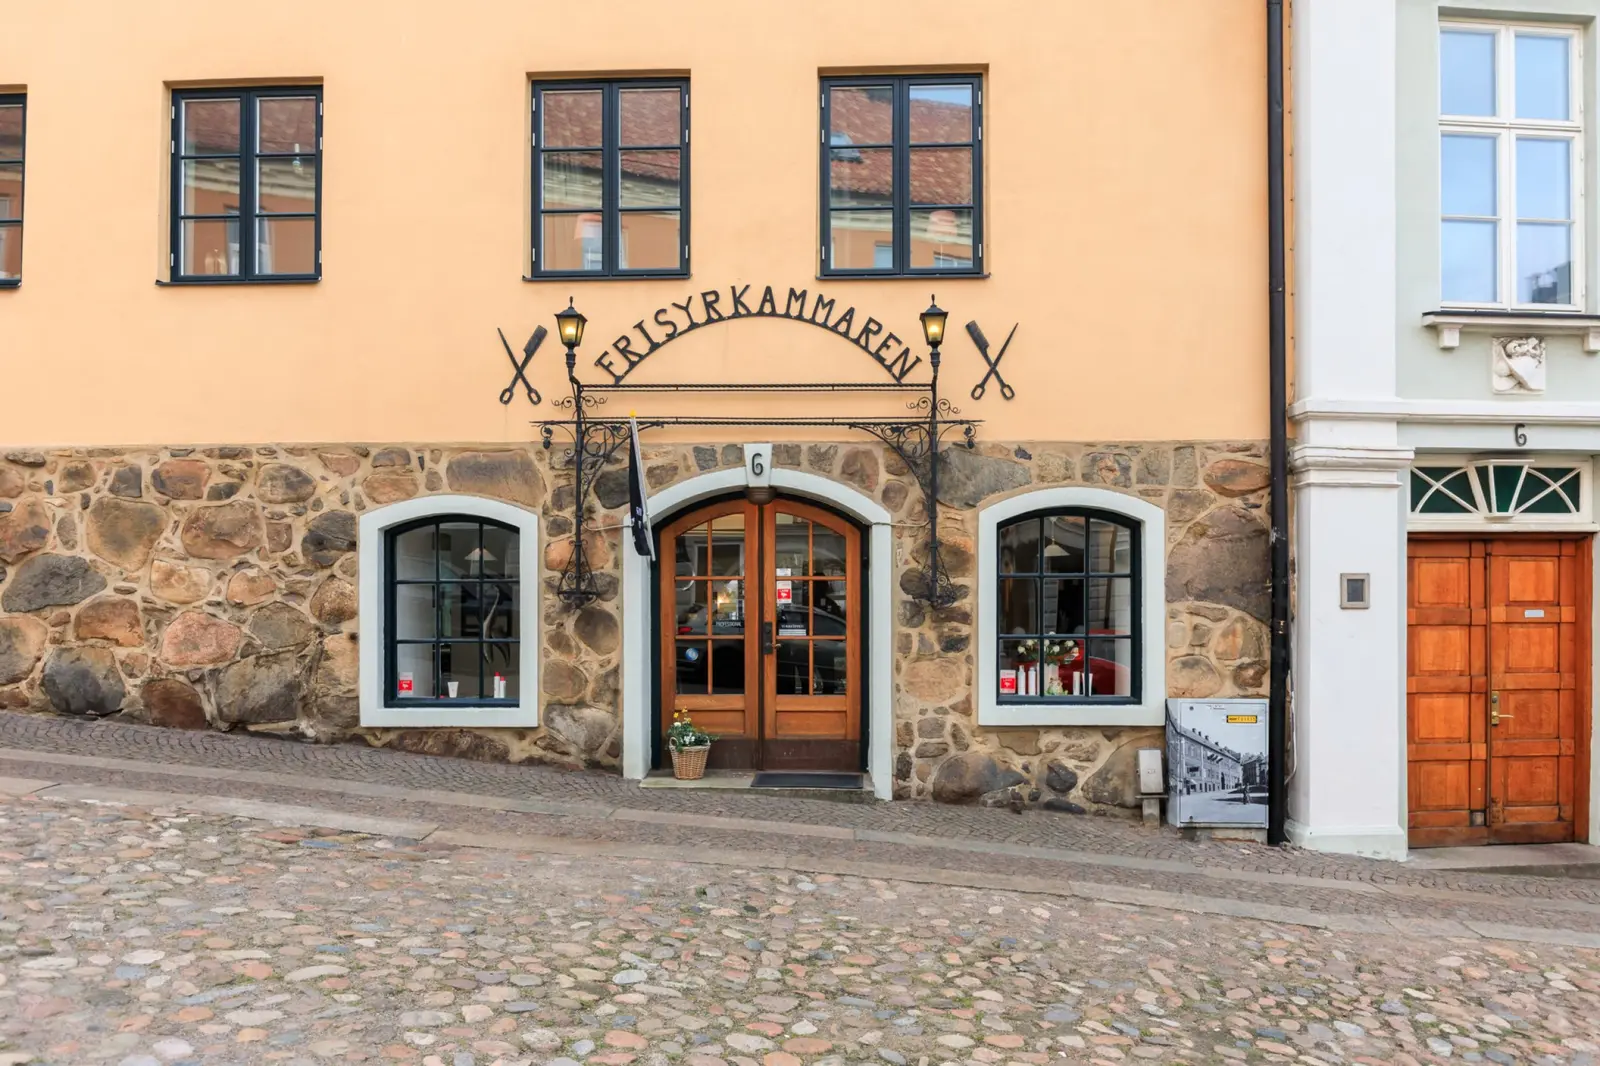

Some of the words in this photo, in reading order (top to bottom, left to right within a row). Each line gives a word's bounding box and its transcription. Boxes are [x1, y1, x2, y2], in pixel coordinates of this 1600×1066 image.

[594, 284, 922, 384] FRISYRKAMMAREN
[1514, 423, 1527, 447] 6
[752, 452, 764, 476] 6
